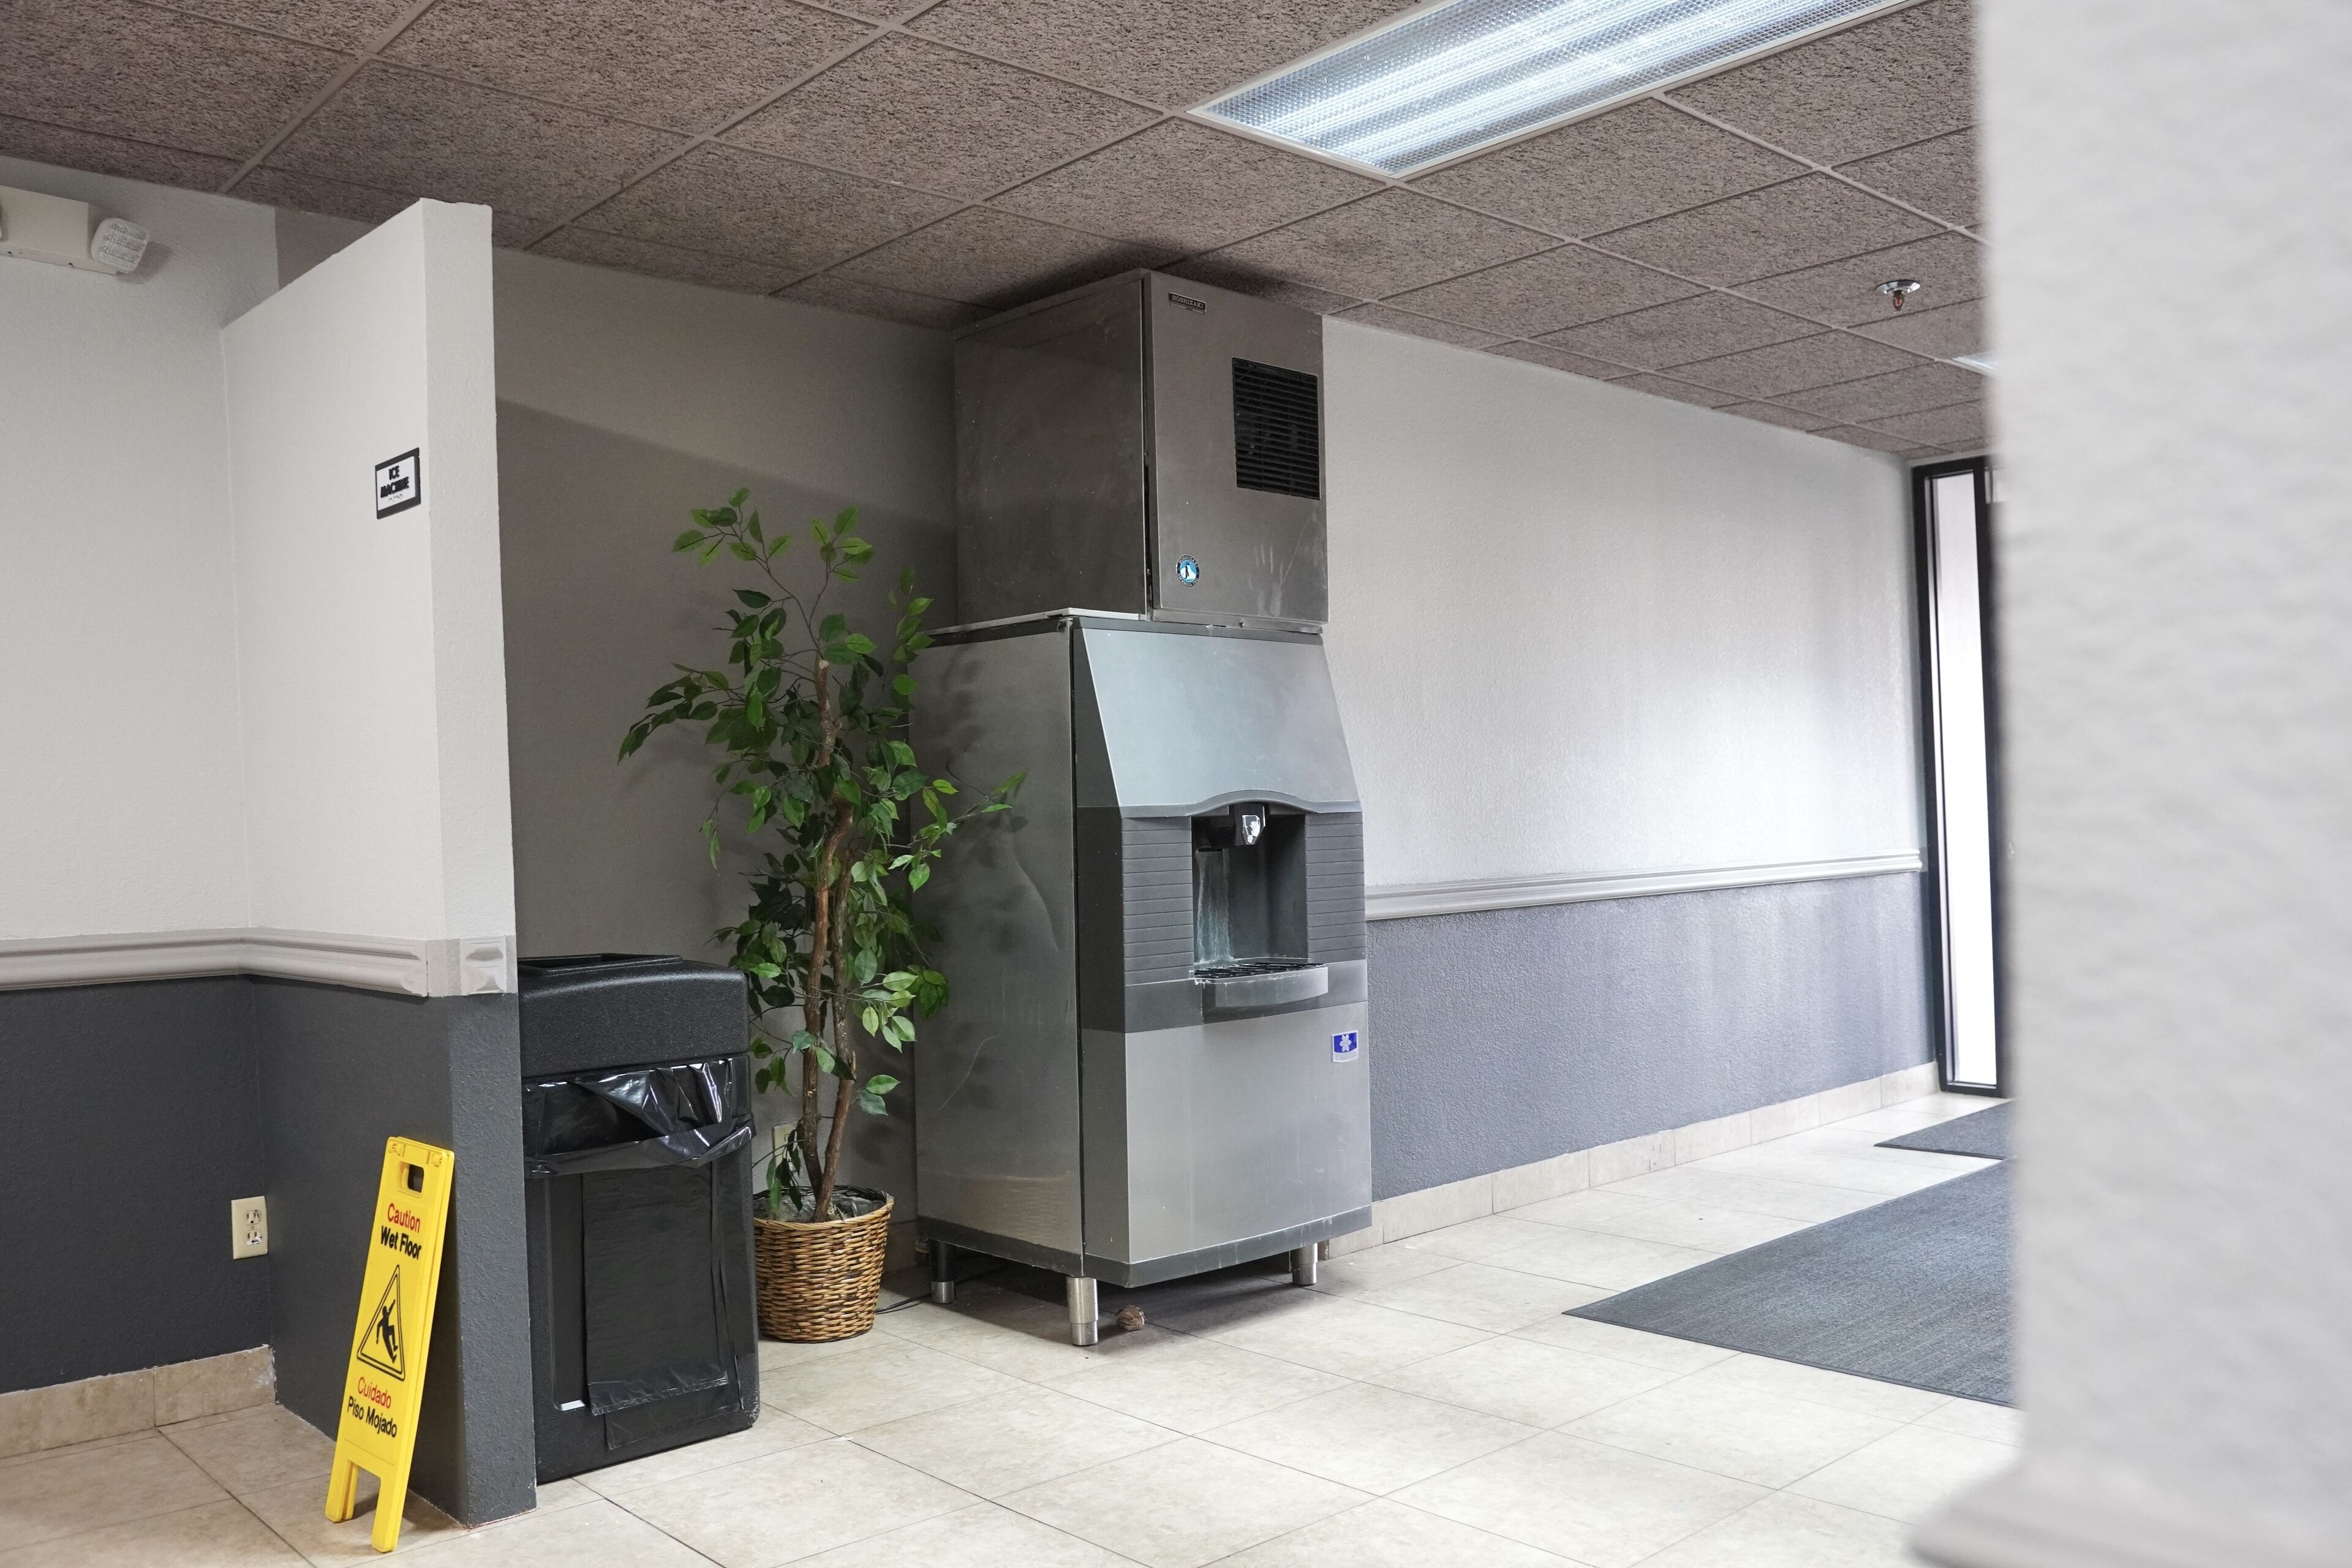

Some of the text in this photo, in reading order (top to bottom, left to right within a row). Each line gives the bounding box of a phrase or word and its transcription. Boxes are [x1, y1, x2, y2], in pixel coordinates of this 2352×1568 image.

[1172, 295, 1204, 309] HOSHIZAKI
[389, 466, 399, 480] ICE
[388, 1203, 420, 1233] Caution
[381, 1226, 421, 1260] Wet Floor
[358, 1377, 391, 1409] Cuidado
[347, 1396, 397, 1438] Piso Mojado
